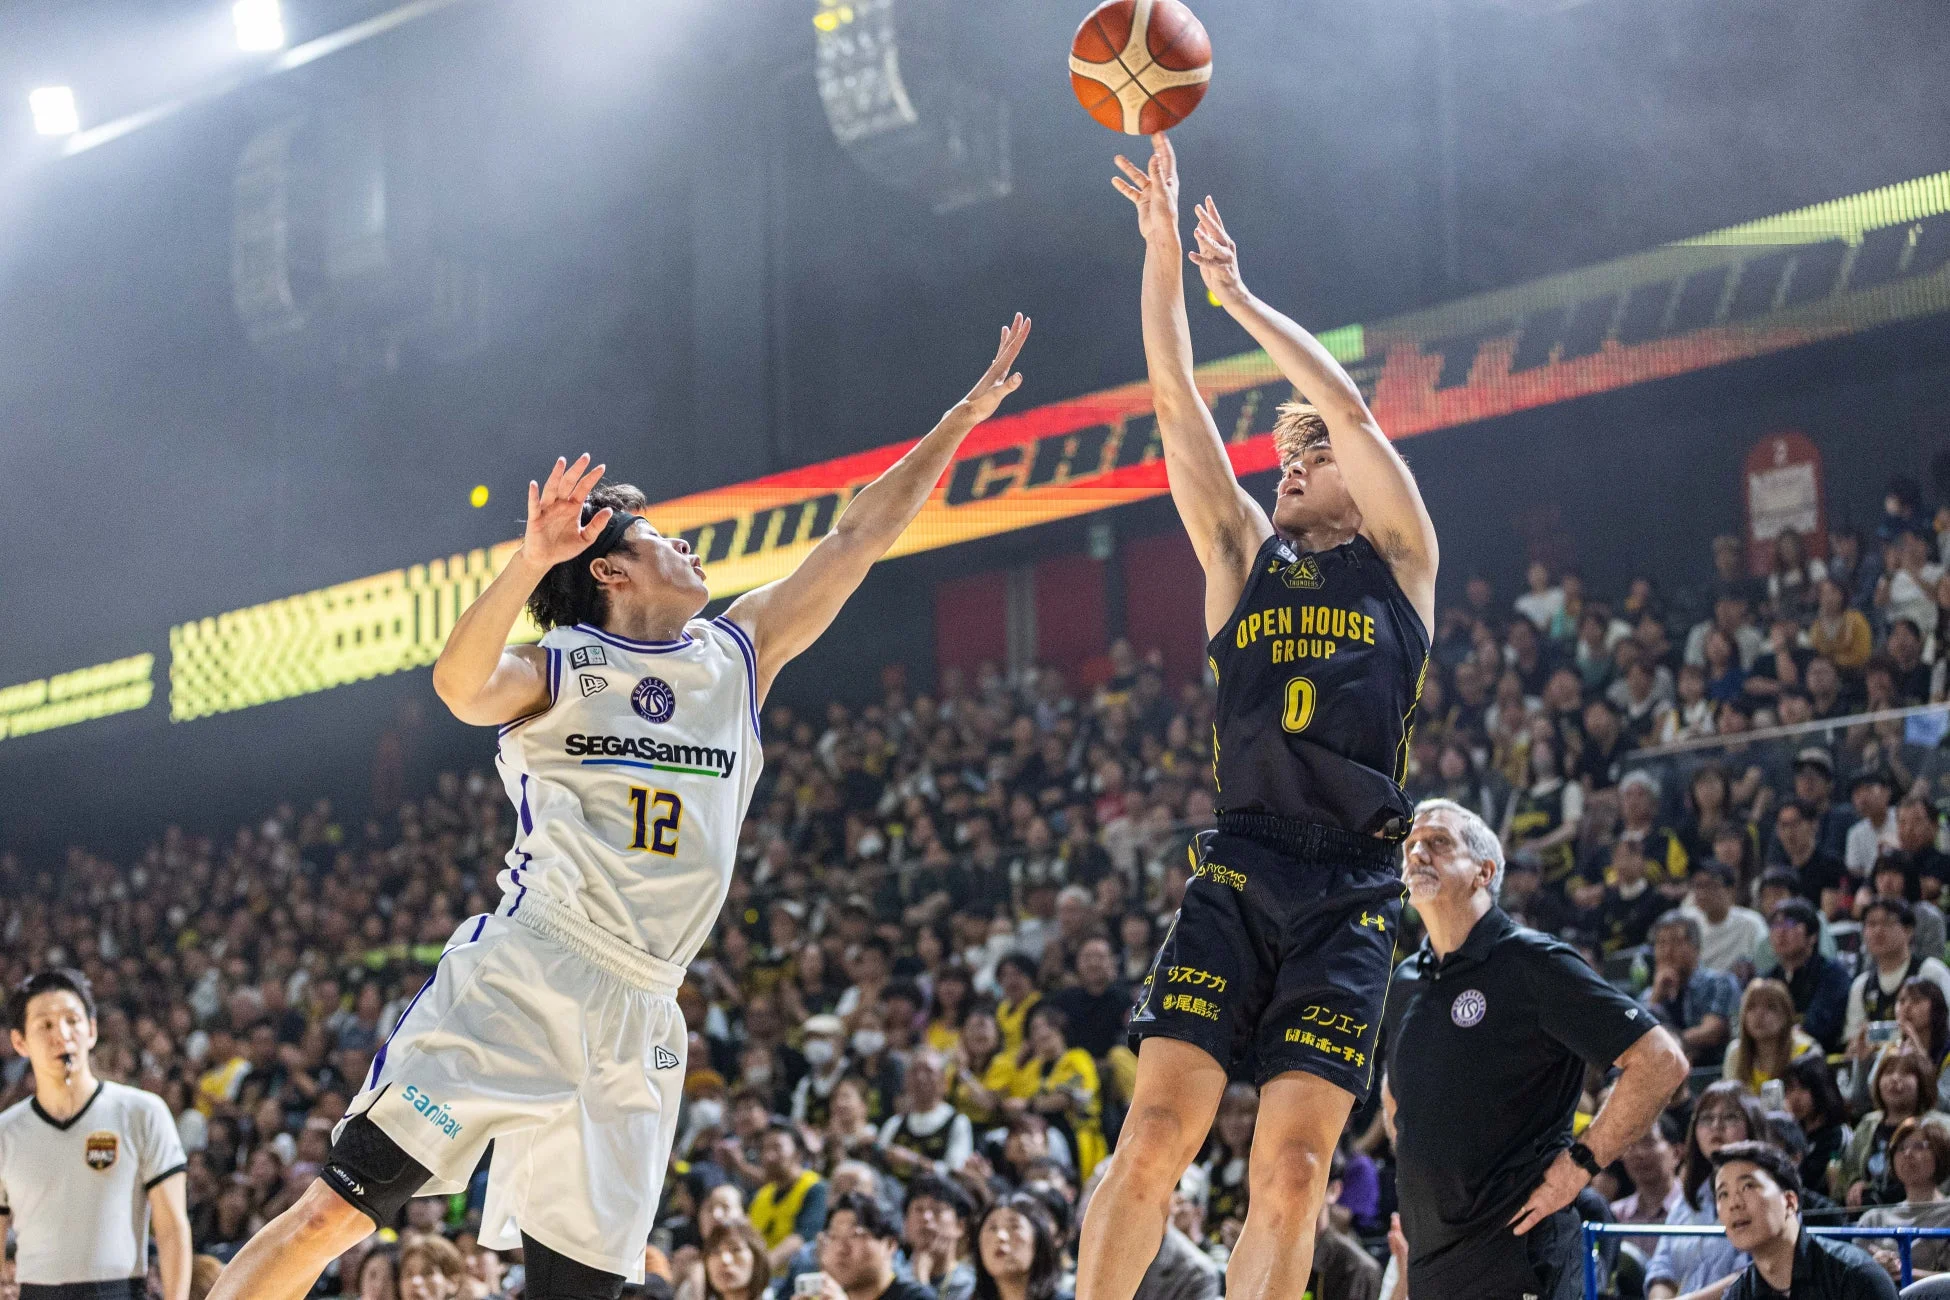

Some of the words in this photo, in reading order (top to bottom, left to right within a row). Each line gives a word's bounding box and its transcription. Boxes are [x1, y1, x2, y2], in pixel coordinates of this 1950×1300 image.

[1236, 606, 1292, 649] OPEN
[1301, 605, 1376, 646] HOUSE
[1271, 638, 1336, 665] GROUP
[1281, 676, 1317, 734] 0
[626, 785, 684, 859] 12
[1206, 862, 1247, 884] RYOMO
[1212, 873, 1245, 892] SYSTEMS
[1285, 1028, 1366, 1068] 関東ホーチキ
[401, 1084, 464, 1140] sanipak
